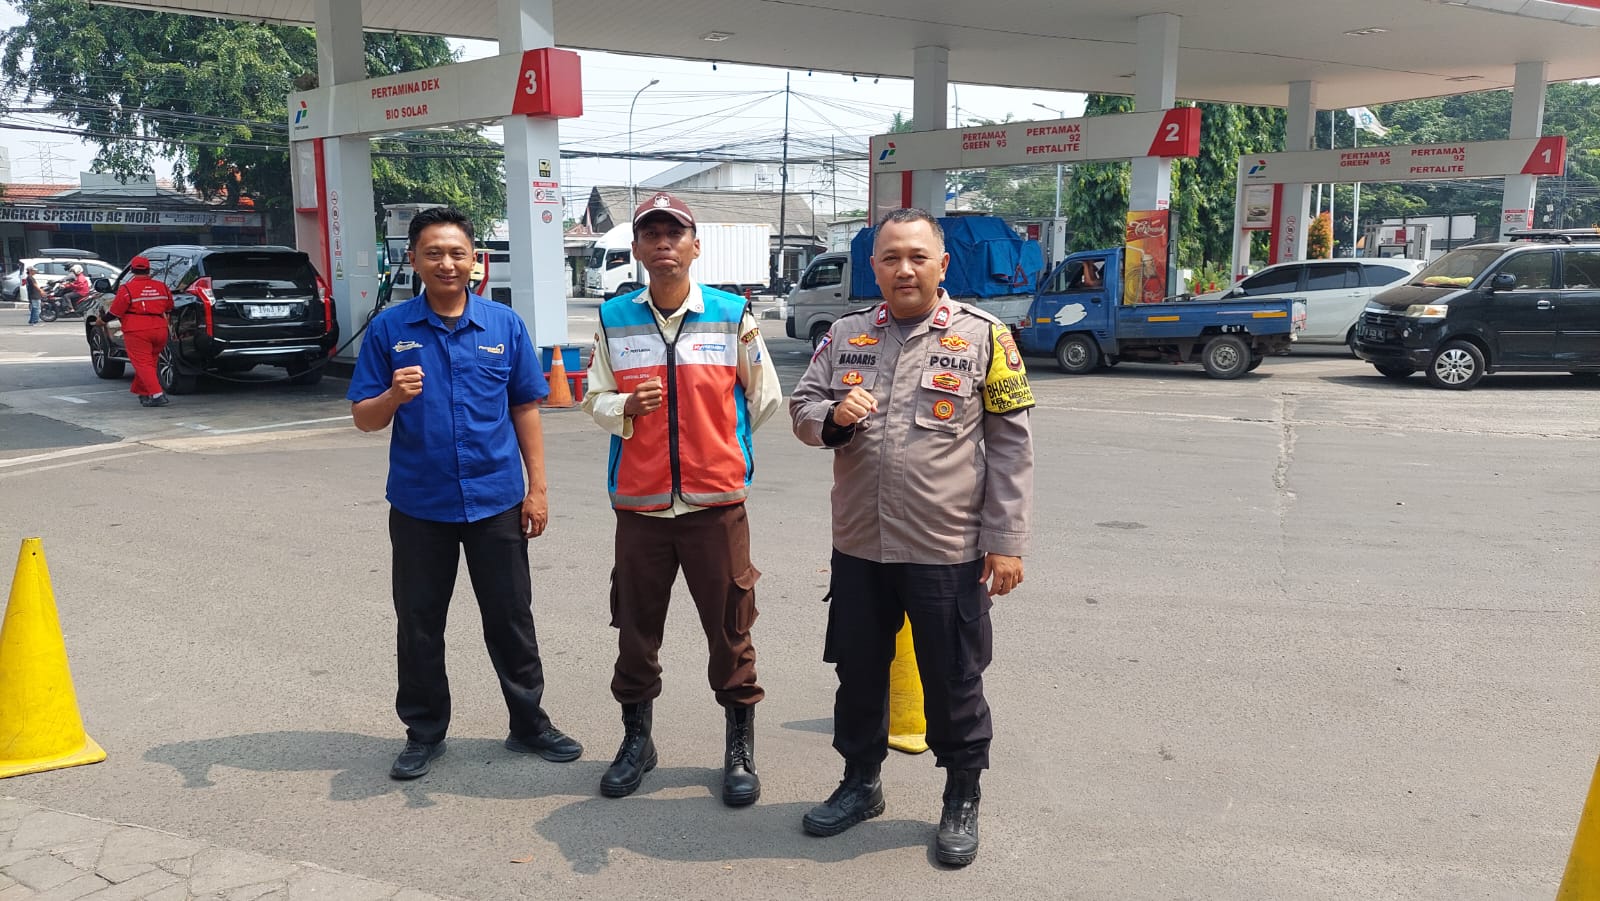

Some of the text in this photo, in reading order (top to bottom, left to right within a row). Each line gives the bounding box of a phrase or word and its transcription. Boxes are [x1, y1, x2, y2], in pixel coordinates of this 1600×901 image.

[371, 77, 440, 100] PERTAMINA DEX
[525, 69, 537, 95] 3
[386, 104, 428, 120] BIO SOLAR
[963, 130, 1007, 141] PERTAMAX
[1026, 124, 1081, 137] PERTAMAX
[1165, 123, 1180, 142] 2
[1069, 133, 1081, 143] 92
[962, 139, 1007, 151] GREEN 95
[1026, 142, 1080, 155] PERTALITE
[1341, 151, 1391, 161] PERTAMAX
[1411, 147, 1465, 157] PERTAMAX
[1453, 154, 1465, 162] 92
[1541, 148, 1552, 164] 1
[1340, 158, 1391, 168] GREEN 95
[1410, 165, 1464, 174] PERTALITE
[43, 209, 104, 223] SPESIALIS
[106, 211, 122, 223] AC
[124, 211, 161, 224] MOBIL
[930, 355, 973, 372] POLRI
